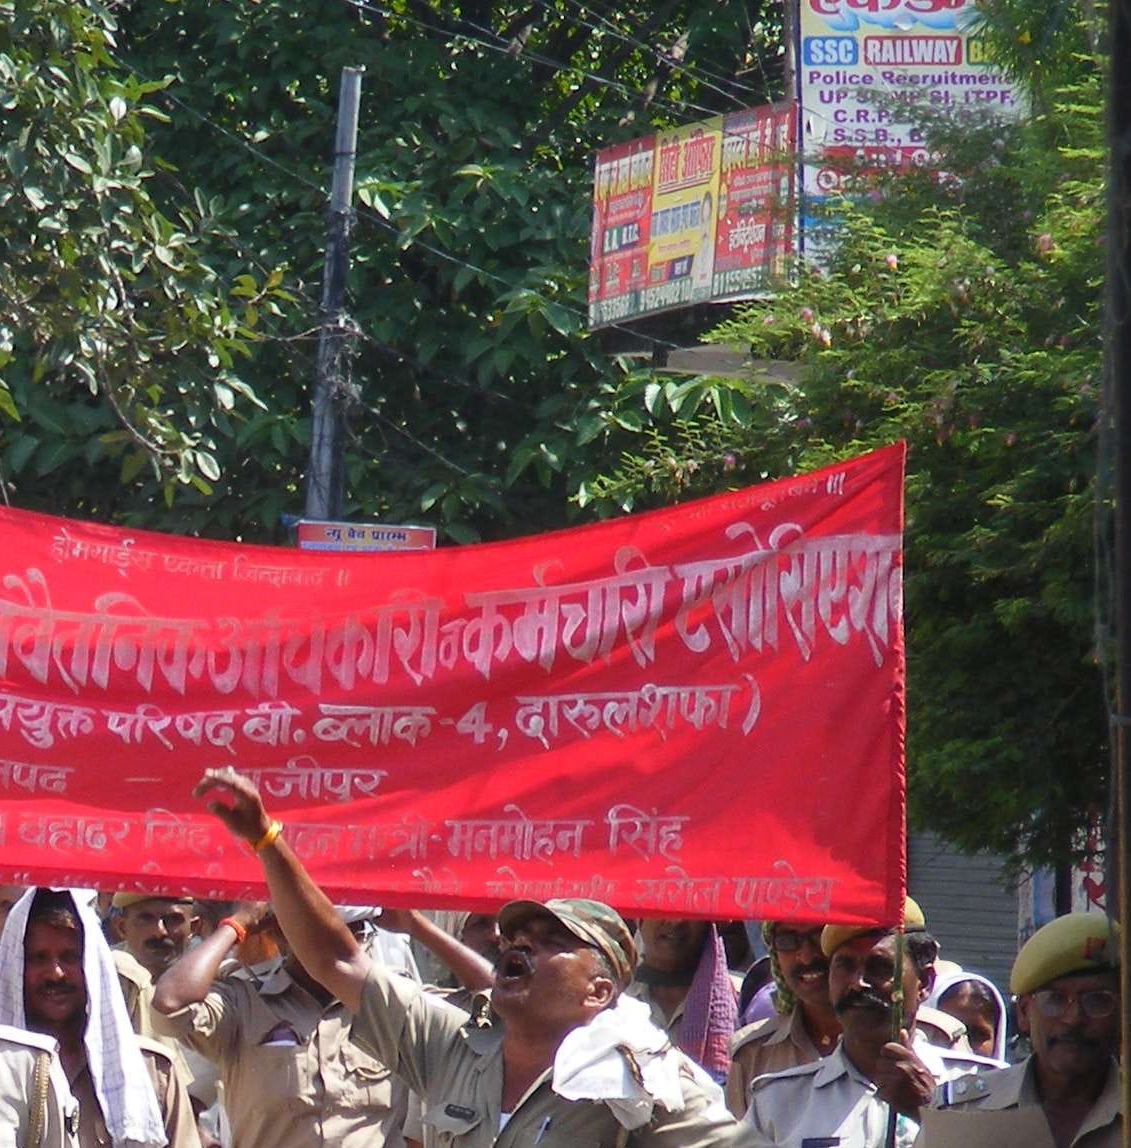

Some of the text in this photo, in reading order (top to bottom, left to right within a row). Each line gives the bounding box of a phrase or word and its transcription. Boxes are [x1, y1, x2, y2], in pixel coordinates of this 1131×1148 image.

[810, 40, 853, 63] SSC
[867, 40, 958, 64] RAILWAY
[809, 71, 873, 85] Police
[819, 91, 848, 104] UP
[445, 804, 595, 866] मनमोहन
[604, 803, 691, 864] सिंह
